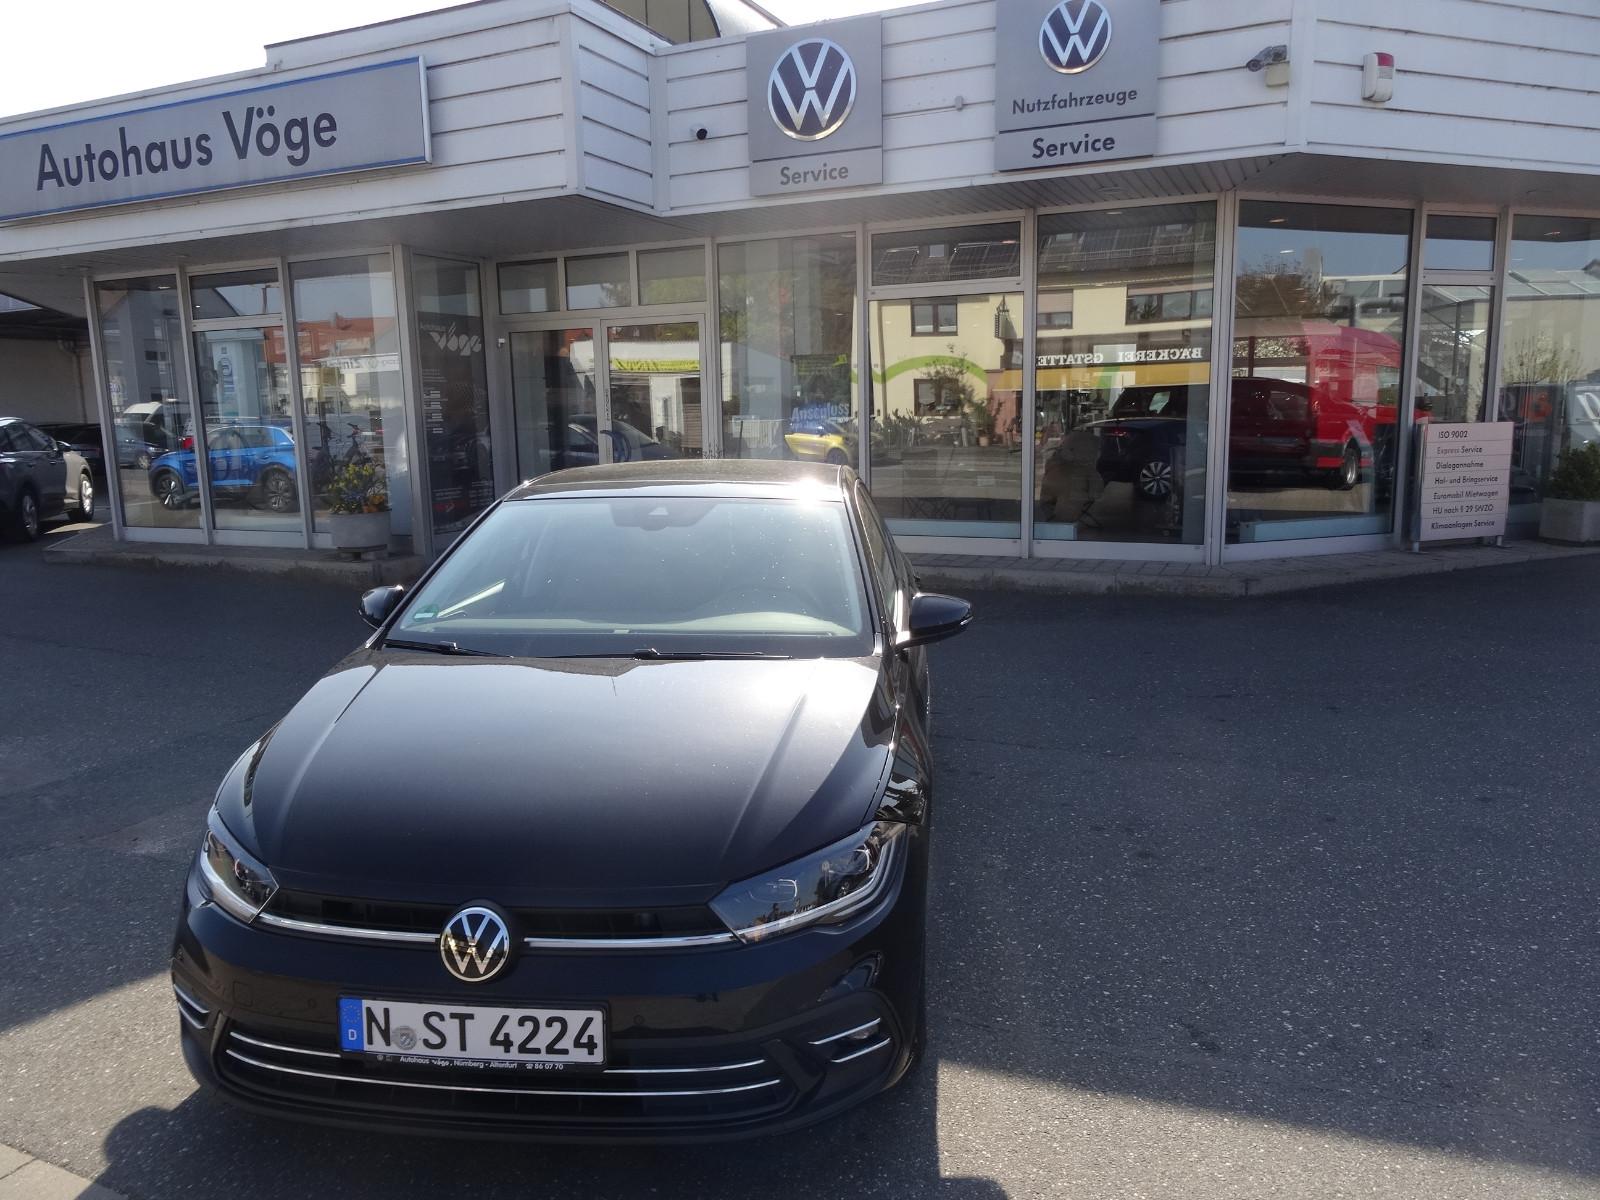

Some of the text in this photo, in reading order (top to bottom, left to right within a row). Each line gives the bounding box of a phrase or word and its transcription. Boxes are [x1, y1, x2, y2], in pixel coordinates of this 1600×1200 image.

[1012, 87, 1138, 115] Nutzfahrzeuge
[36, 104, 338, 191] Autohaus Vöge
[1031, 133, 1116, 160] Service
[779, 162, 850, 186] Service
[1438, 430, 1468, 439] ISO 9002
[1461, 445, 1483, 454] Service
[1449, 476, 1460, 484] und
[1462, 475, 1498, 484] Bringservice
[1432, 507, 1443, 515] HU
[1443, 505, 1459, 514] nach
[1465, 504, 1474, 513] 29
[1431, 519, 1495, 530] Klimaanlagen Service
[348, 1029, 357, 1041] D
[365, 1006, 598, 1056] N ST 4224
[400, 1055, 430, 1065] Autohaus
